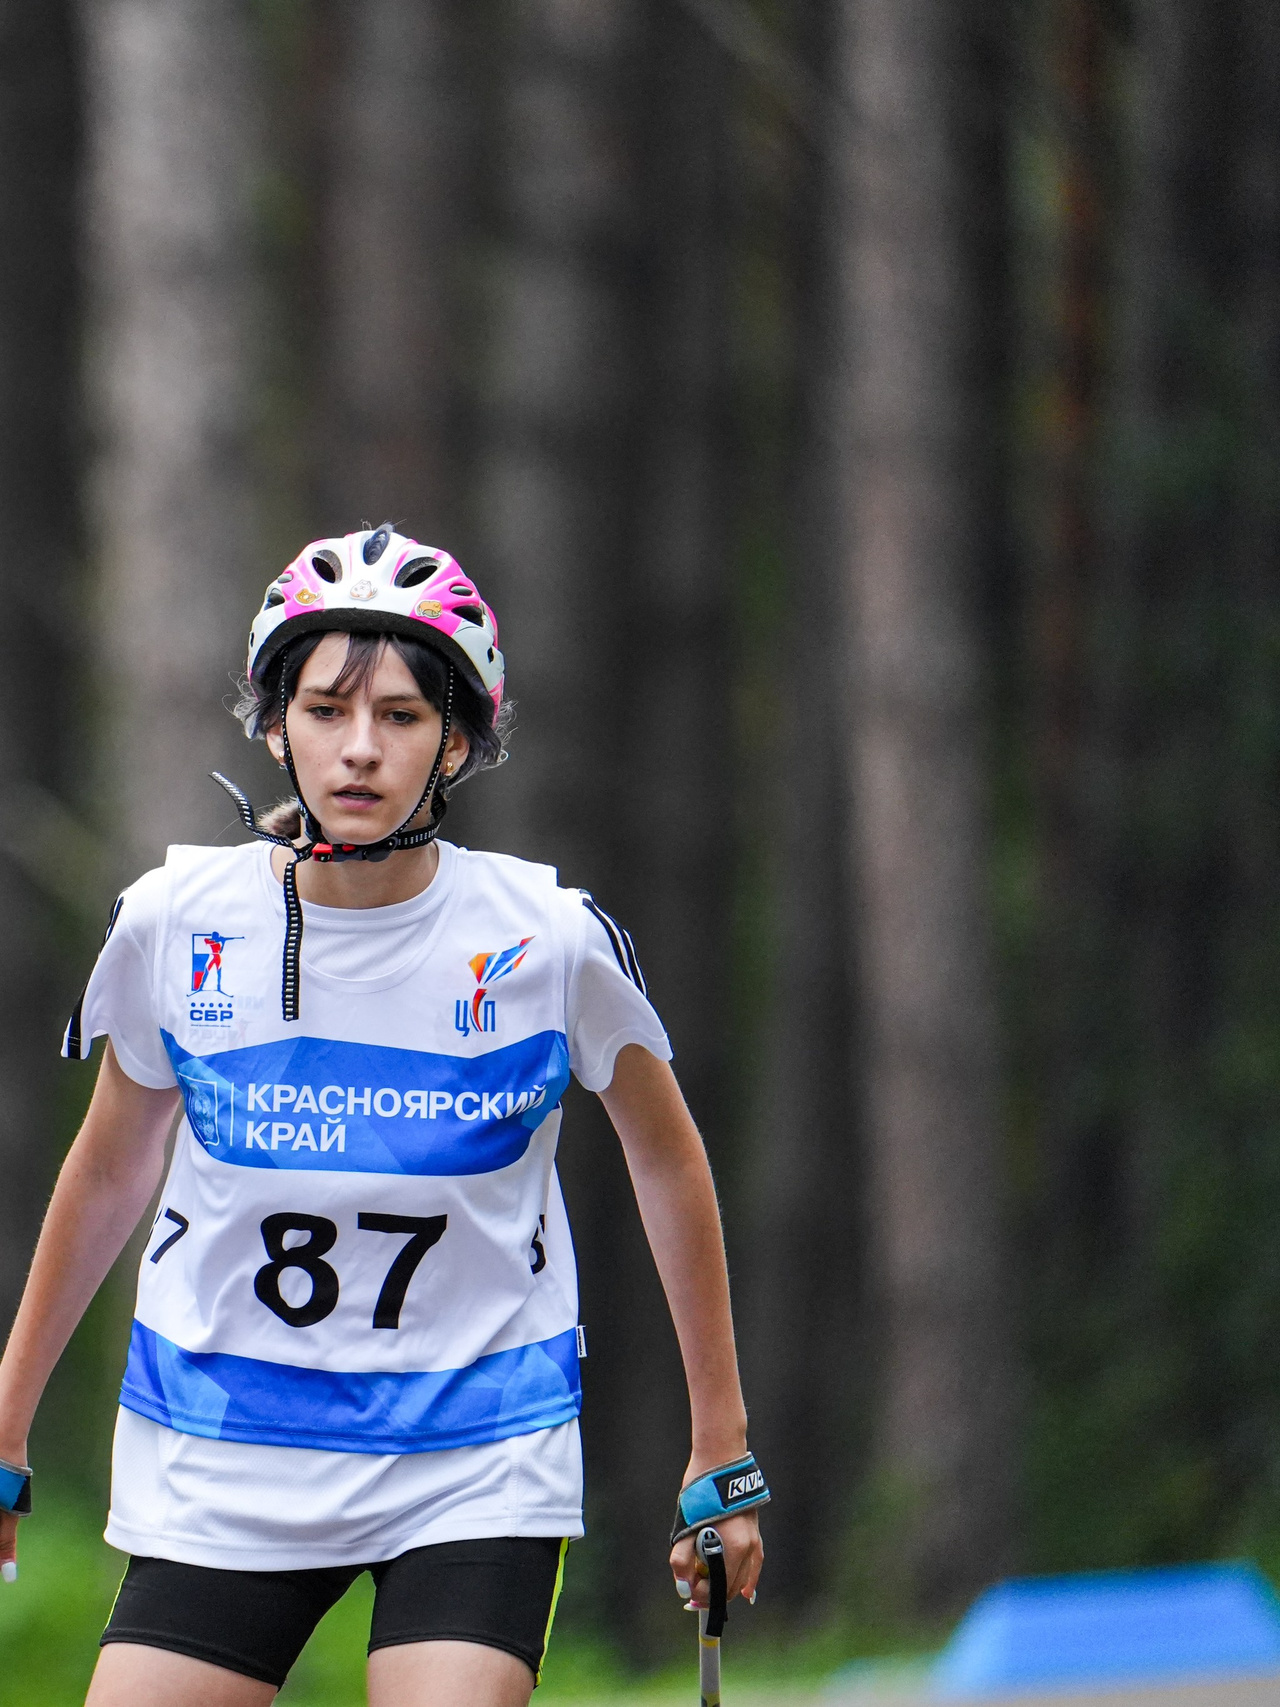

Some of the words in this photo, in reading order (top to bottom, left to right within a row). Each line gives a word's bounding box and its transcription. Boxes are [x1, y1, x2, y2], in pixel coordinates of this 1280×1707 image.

[189, 1009, 233, 1022] СБР
[247, 1083, 547, 1121] КРАСНОЯРСКИЙ
[245, 1117, 347, 1153] КРАЙ
[145, 1205, 189, 1264] 7
[253, 1211, 448, 1329] 87
